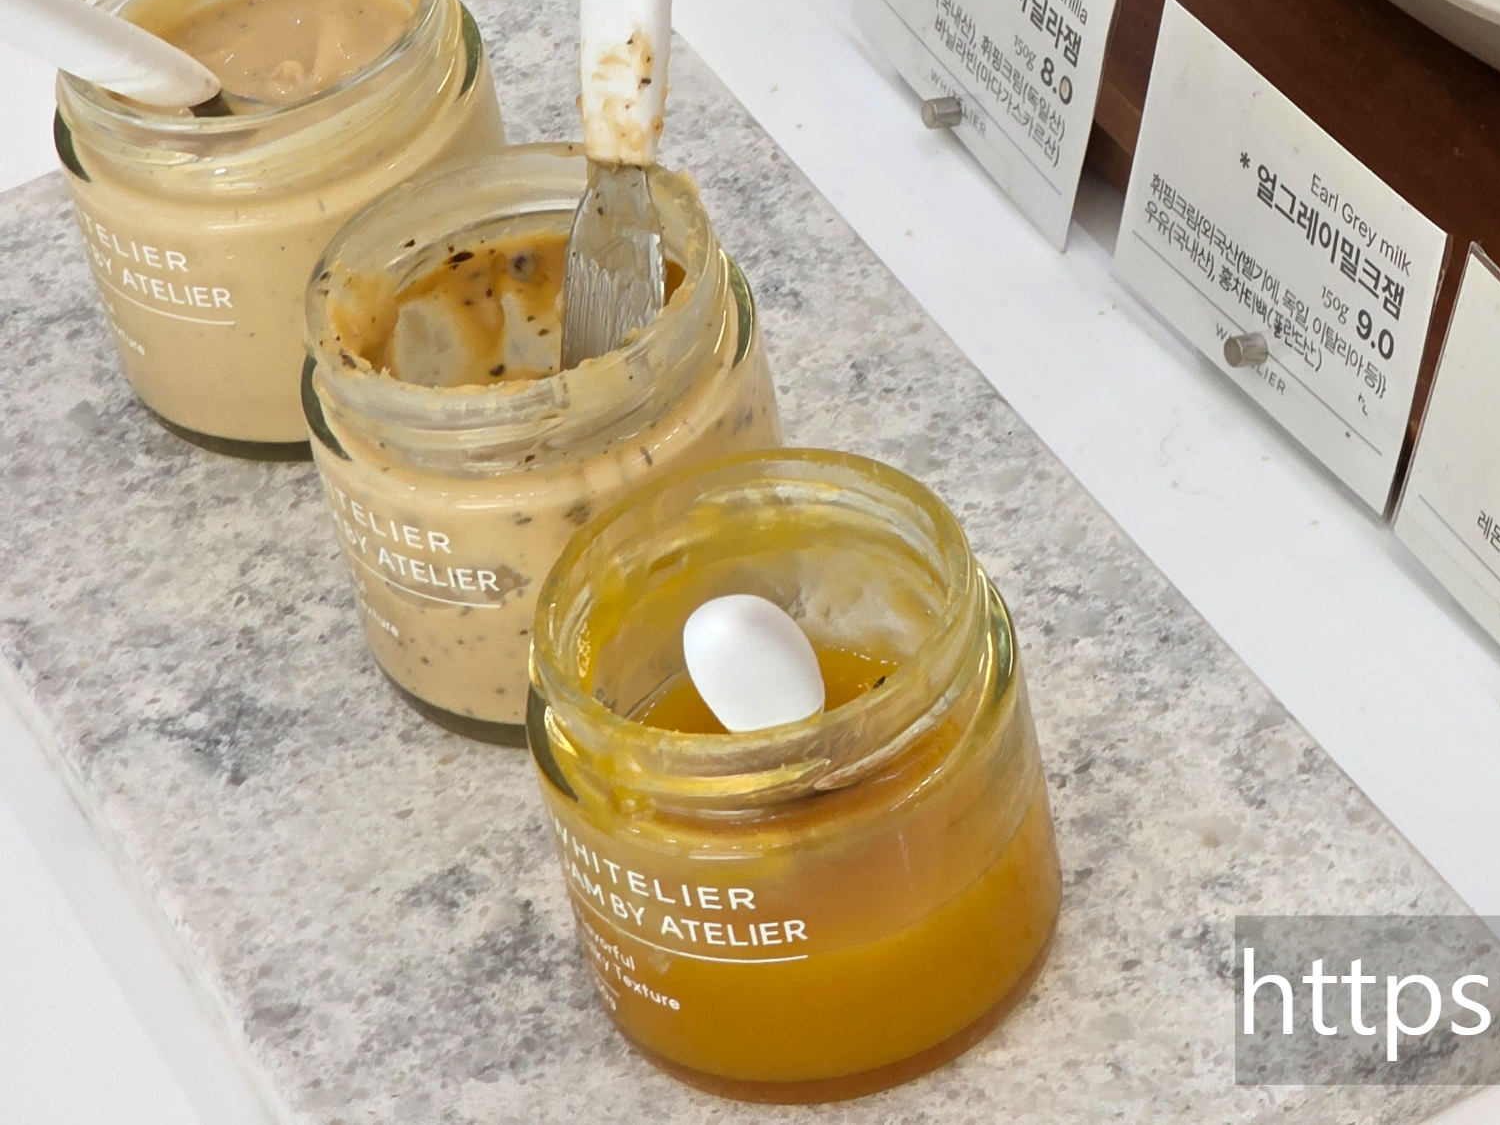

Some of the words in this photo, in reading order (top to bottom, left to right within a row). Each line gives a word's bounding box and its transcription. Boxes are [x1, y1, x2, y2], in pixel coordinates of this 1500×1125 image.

[1014, 34, 1037, 72] 150g
[1040, 56, 1073, 106] 8.0
[1256, 164, 1405, 322] 얼그레이밀크잼
[1309, 173, 1339, 213] Earl
[1341, 201, 1377, 249] Grey
[1380, 234, 1412, 277] milk
[123, 268, 233, 309] ATELIER
[1313, 317, 1364, 377] 이탈리아
[1321, 286, 1349, 324] 150g
[1356, 309, 1395, 360] 9.0
[378, 547, 501, 592] ATELIER
[610, 892, 645, 926] BY
[661, 915, 809, 947] ATELIER
[612, 962, 681, 1011] Texture
